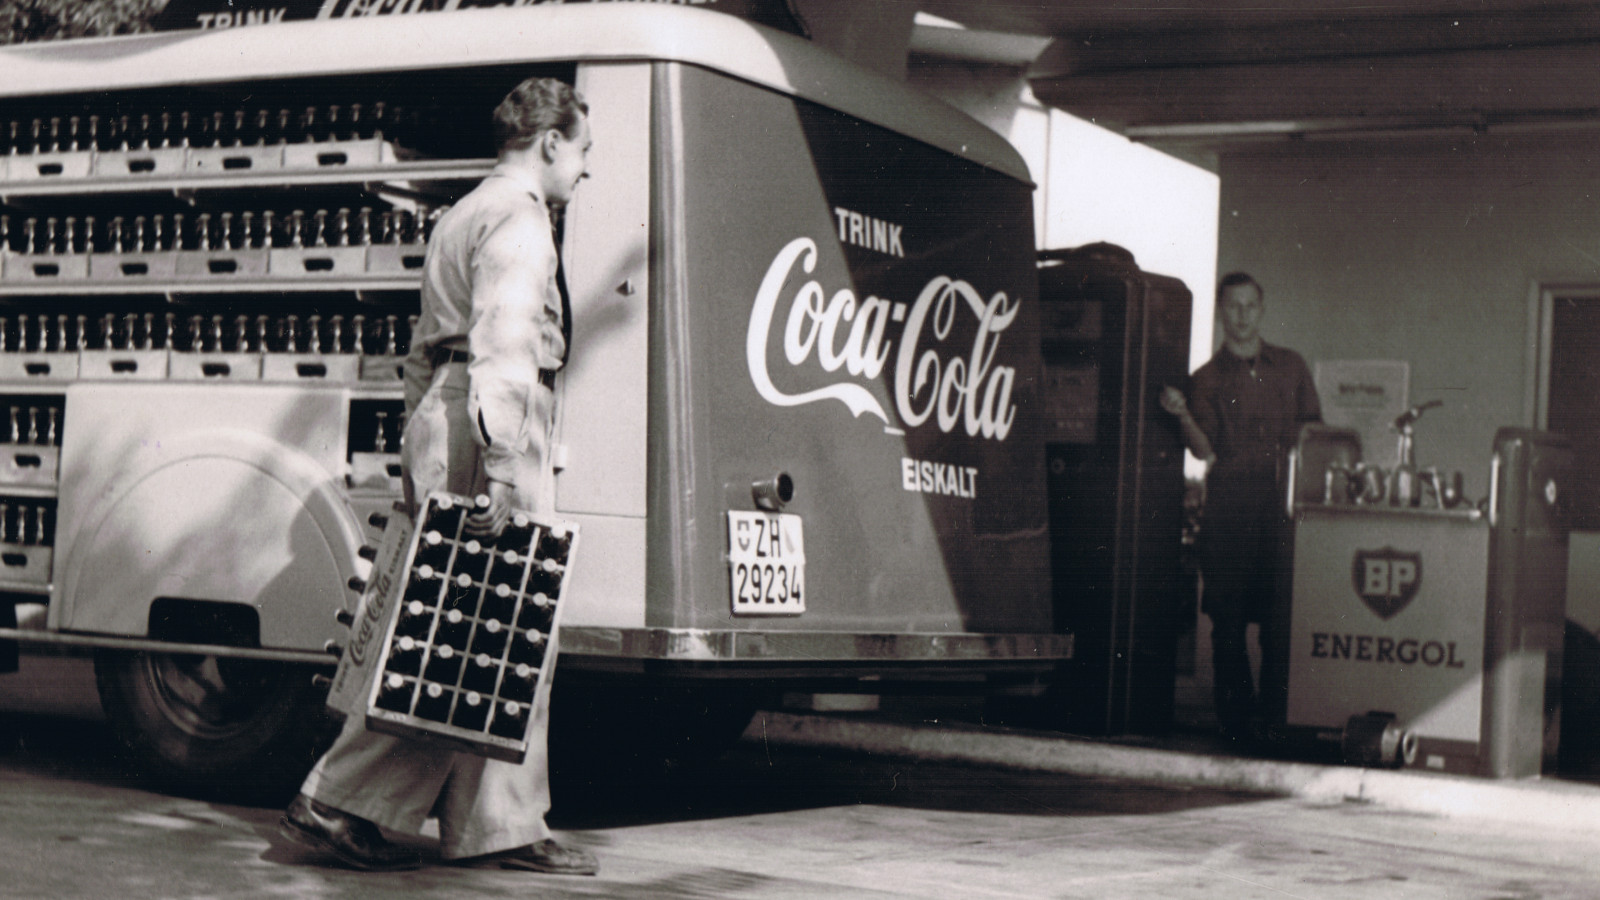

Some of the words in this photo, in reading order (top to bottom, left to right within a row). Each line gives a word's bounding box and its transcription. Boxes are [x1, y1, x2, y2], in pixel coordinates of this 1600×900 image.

[835, 206, 904, 257] TRINK
[746, 236, 1020, 441] Coca-Cola
[901, 457, 978, 499] EISKALT
[755, 519, 782, 557] ZH
[737, 563, 801, 604] 29234
[1363, 558, 1416, 597] BP
[1310, 632, 1465, 669] ENERGOL
